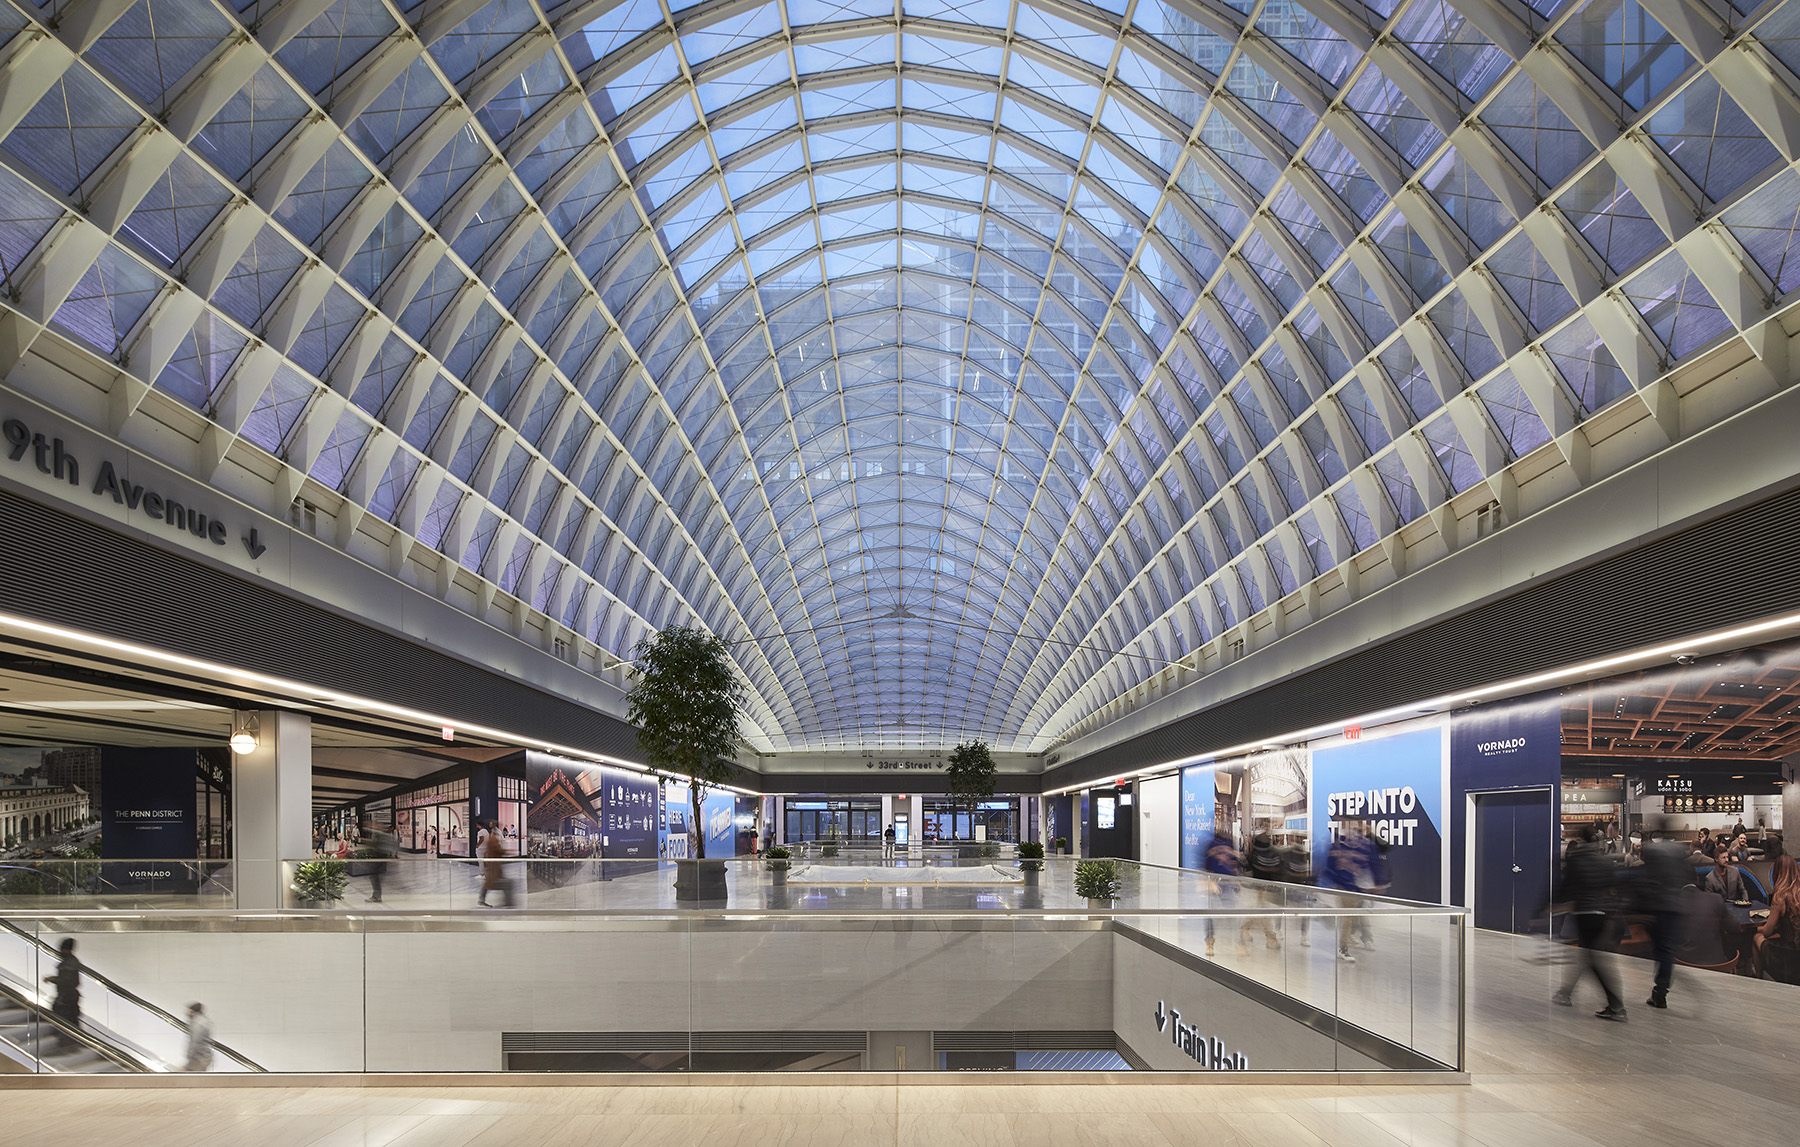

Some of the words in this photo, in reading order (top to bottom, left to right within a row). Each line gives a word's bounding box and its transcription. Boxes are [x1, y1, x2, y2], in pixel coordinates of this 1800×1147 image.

[3, 419, 79, 485] 9th
[93, 461, 227, 545] Avenue
[1477, 737, 1526, 753] VORNADO
[878, 761, 898, 769] 33rd
[904, 761, 932, 769] Street
[1184, 790, 1196, 802] Dear
[1327, 791, 1365, 817] STEP
[1367, 786, 1416, 814] INTO
[115, 810, 129, 818] THE
[130, 810, 151, 818] PENN
[152, 810, 183, 818] DISTRICT
[1184, 805, 1195, 816] New
[1327, 820, 1360, 844] TH
[669, 839, 685, 857] FOOD
[128, 870, 171, 878] VORNADO
[1169, 1009, 1207, 1068] Train
